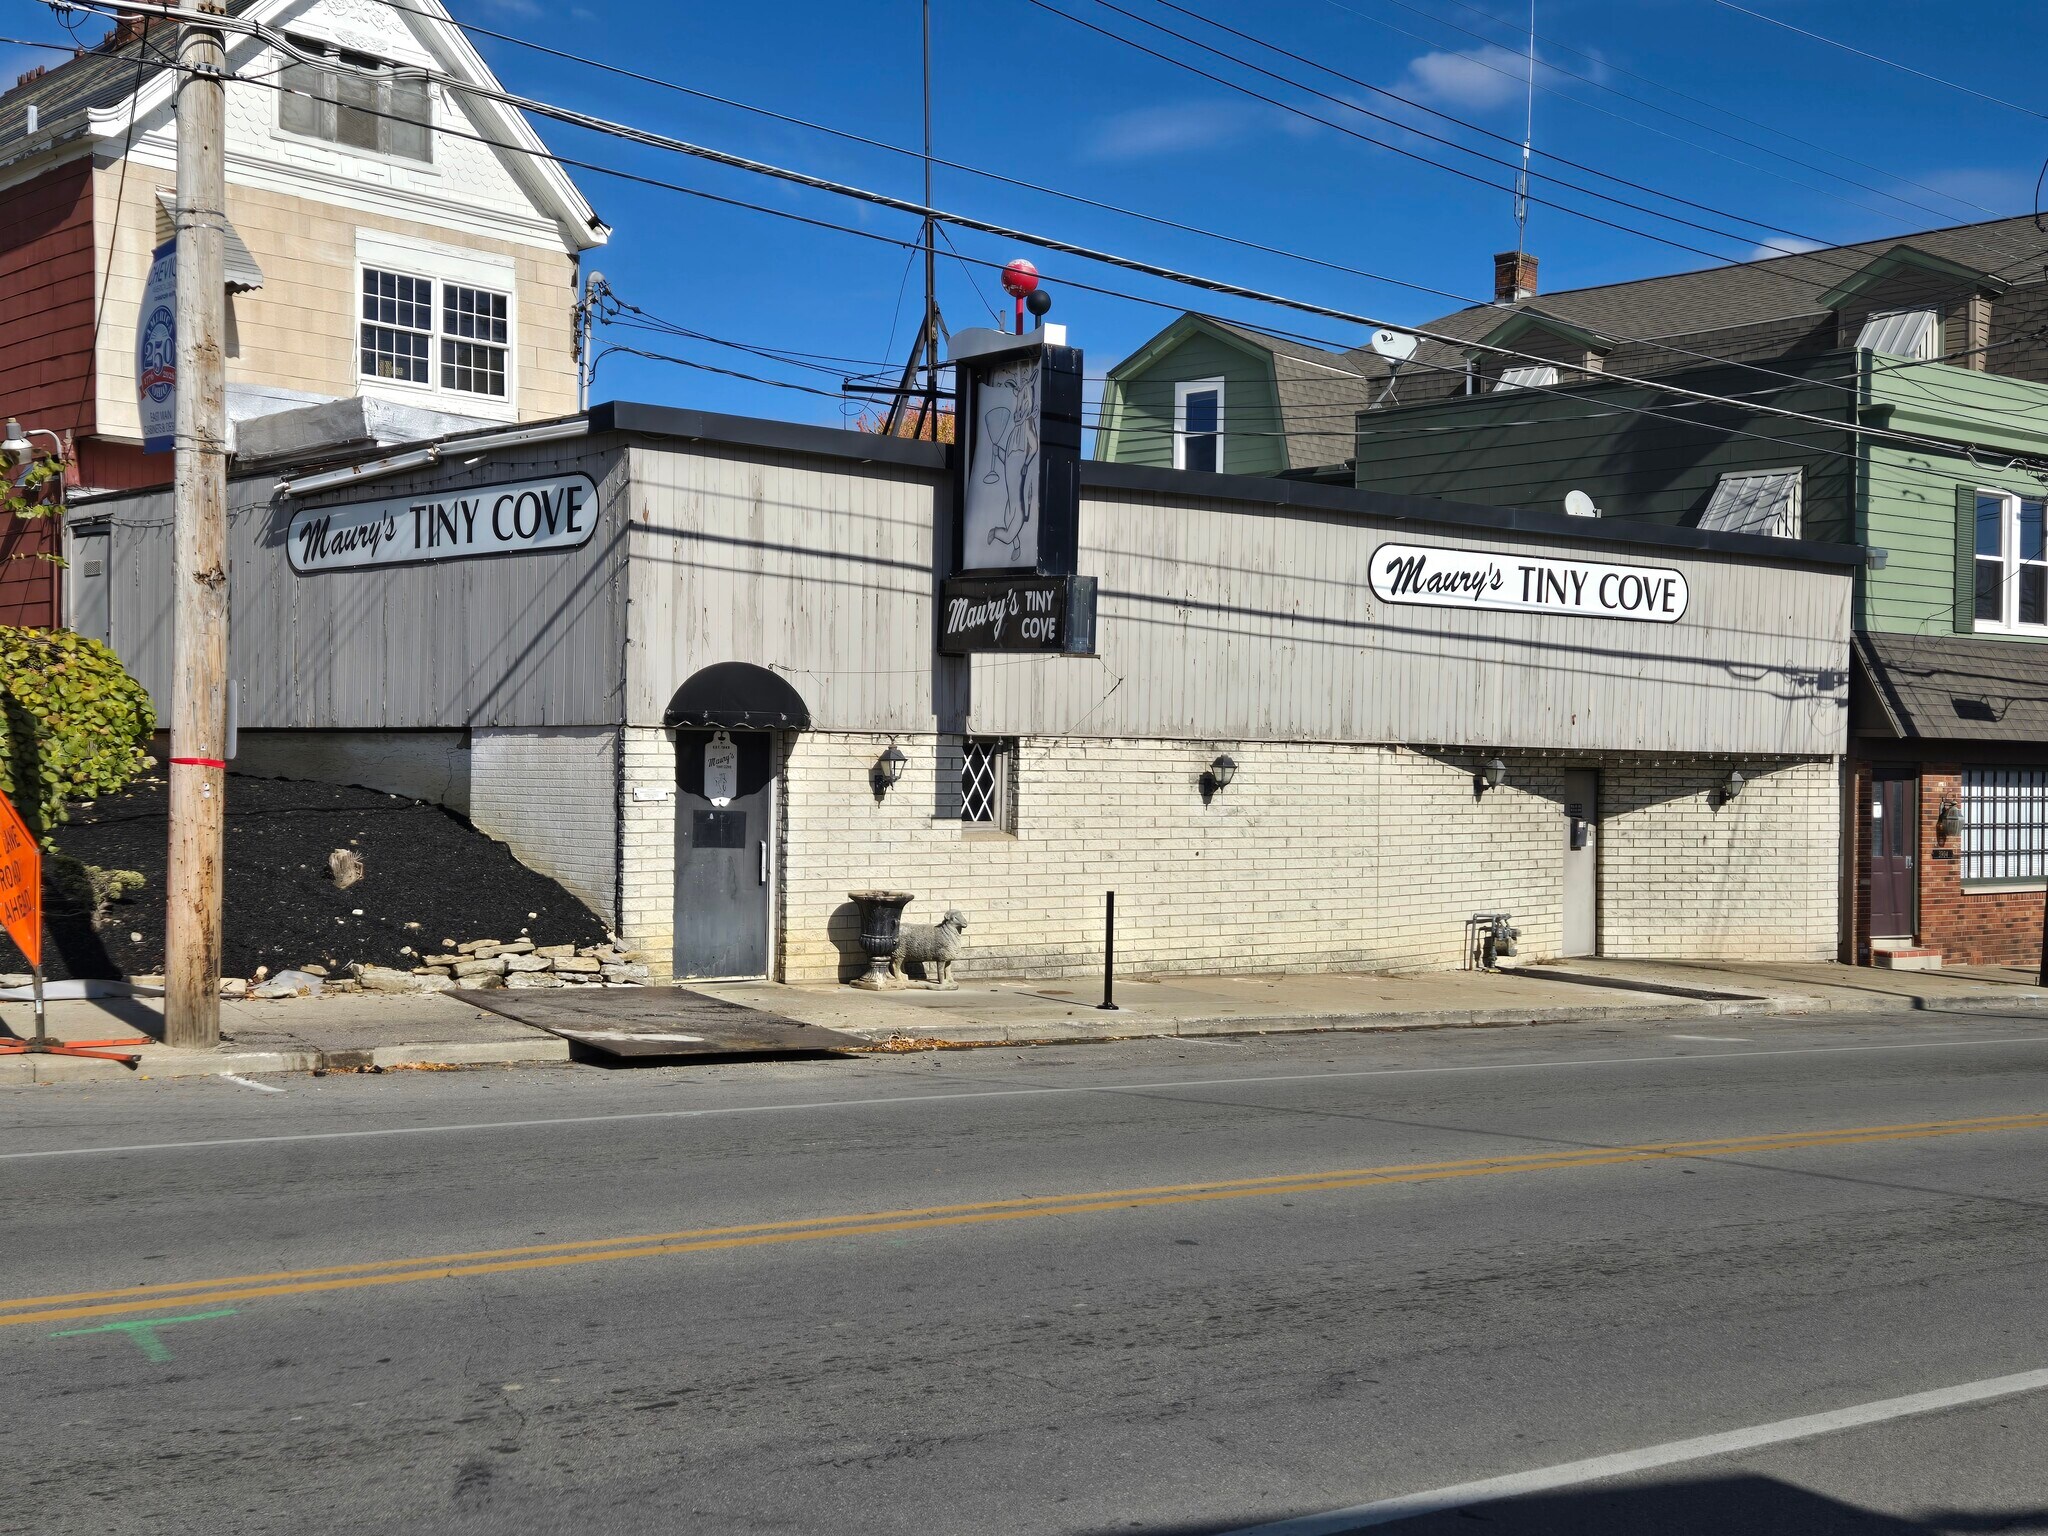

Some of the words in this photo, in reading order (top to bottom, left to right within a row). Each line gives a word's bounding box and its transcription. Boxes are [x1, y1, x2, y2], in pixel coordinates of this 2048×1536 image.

[144, 337, 174, 375] 250
[151, 383, 168, 398] OHIO
[299, 510, 398, 564] Maury's
[409, 498, 480, 549] TINY
[492, 485, 582, 541] COVE
[1386, 554, 1504, 602] Maury's
[1518, 565, 1589, 606] TINY
[1599, 573, 1676, 613] COVE
[947, 588, 1020, 641] Maury's
[1025, 590, 1054, 613] TINY
[1021, 617, 1056, 642] COVE
[3, 824, 21, 854] LANE
[0, 860, 21, 892] ROAD
[4, 889, 32, 926] AHEAD
